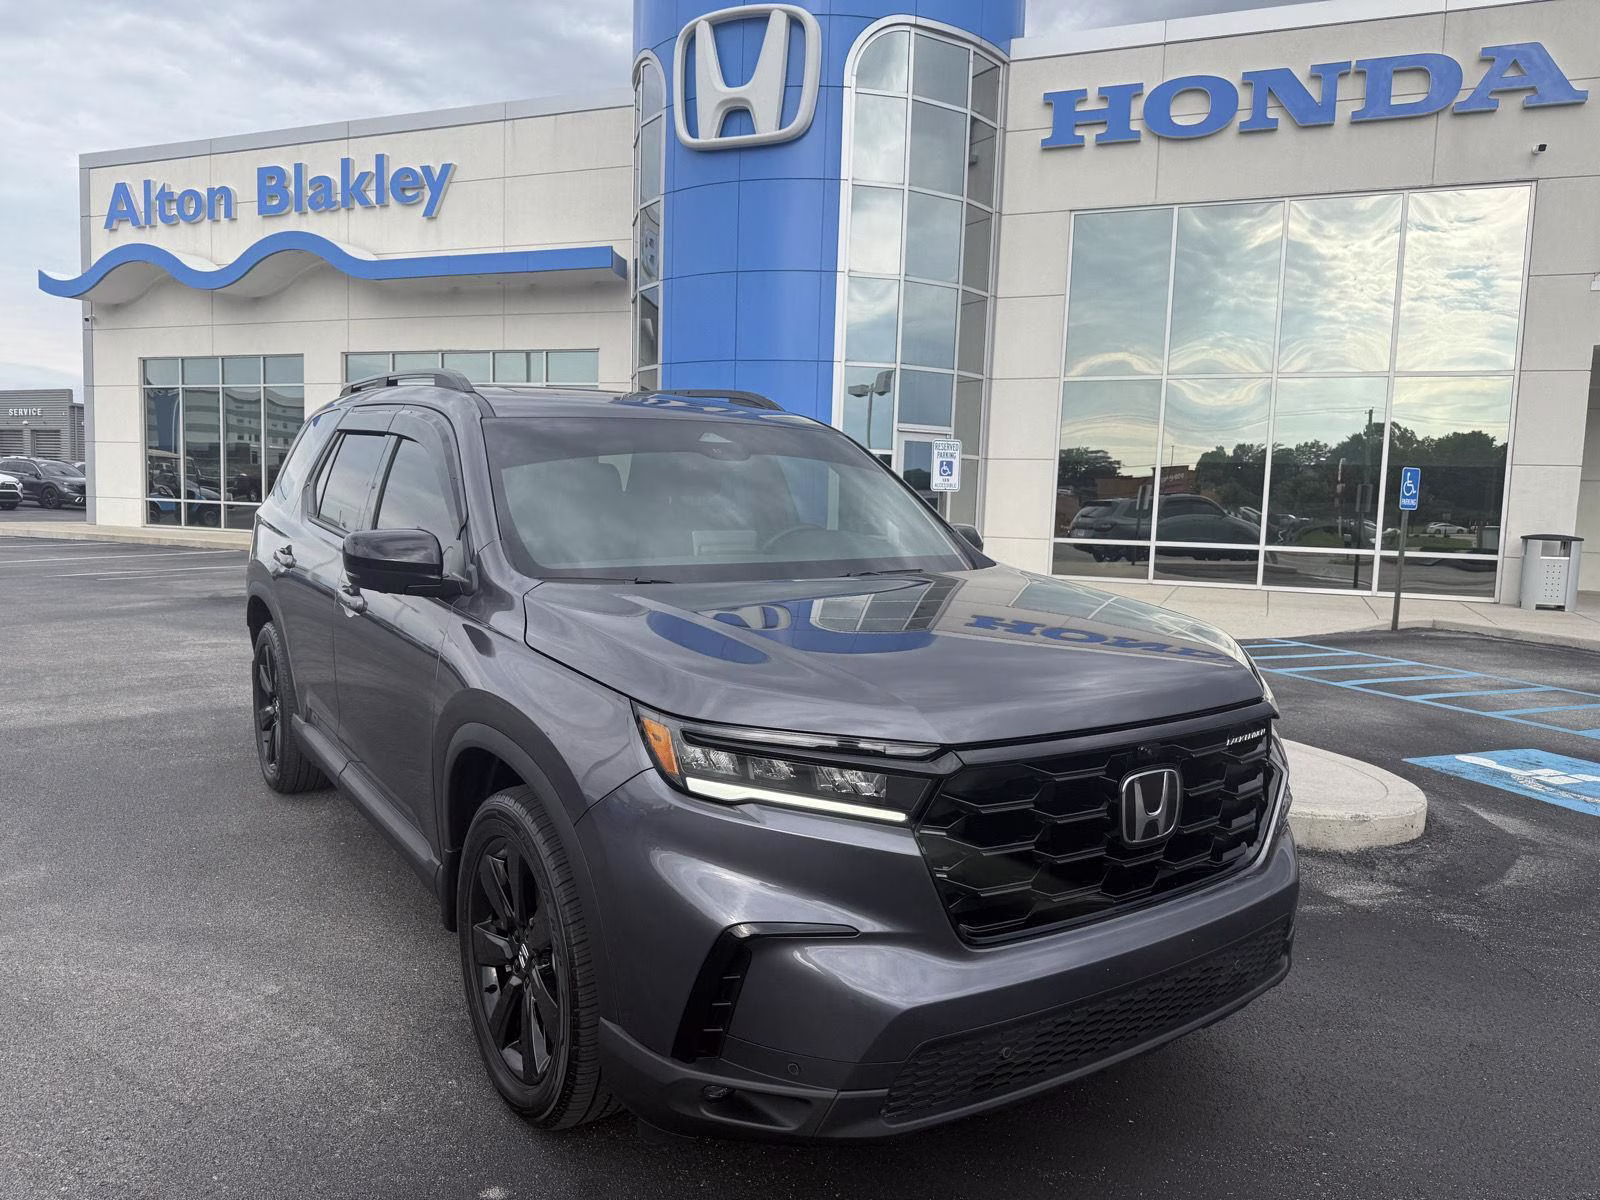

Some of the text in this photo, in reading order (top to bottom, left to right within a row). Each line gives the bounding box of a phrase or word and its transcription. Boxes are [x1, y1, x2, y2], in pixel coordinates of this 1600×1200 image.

[1040, 41, 1589, 150] HONDA
[103, 153, 457, 230] Alton Blakley
[8, 408, 42, 416] SERVICE
[935, 442, 960, 451] RESERVED
[936, 451, 957, 460] PARKING
